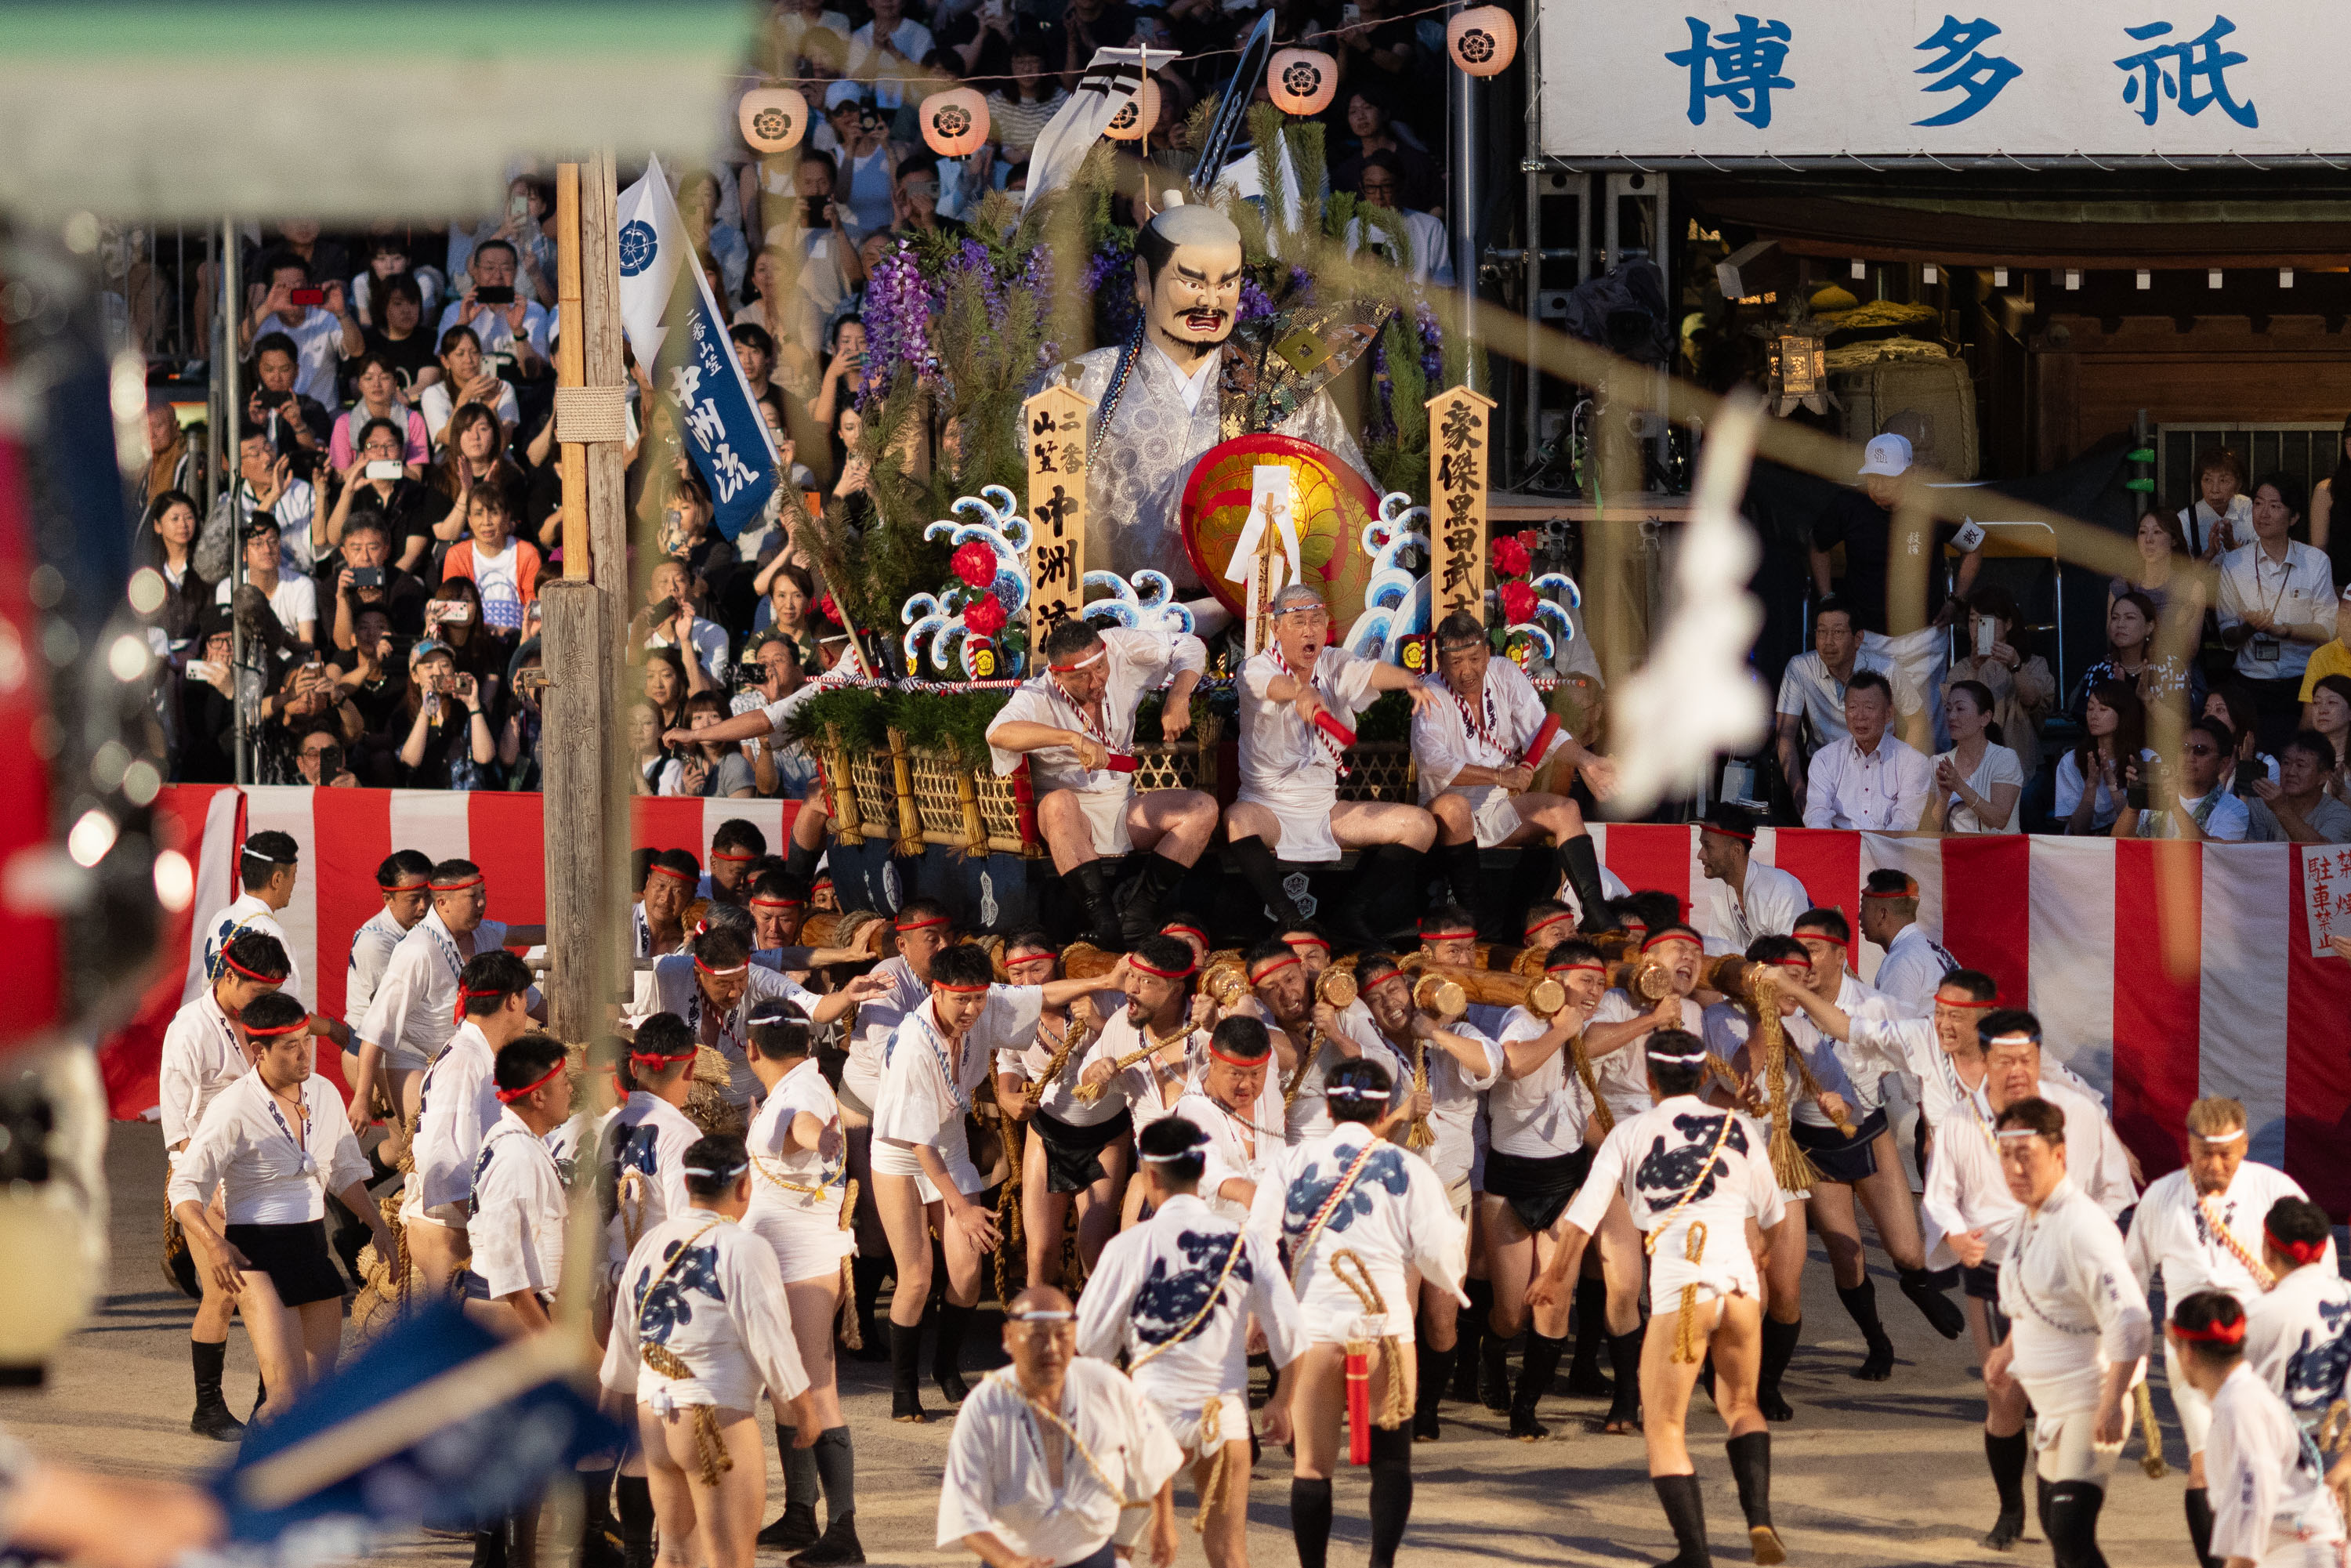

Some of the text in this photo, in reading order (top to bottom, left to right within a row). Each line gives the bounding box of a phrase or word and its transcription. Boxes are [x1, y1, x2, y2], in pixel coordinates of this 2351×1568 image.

[1664, 13, 2259, 129] 博多祇
[686, 308, 723, 376] 二番山笠
[668, 365, 759, 504] 中洲流
[1033, 411, 1058, 475] 山笠
[1058, 411, 1085, 475] 二番
[2307, 856, 2334, 950] 駐車禁止
